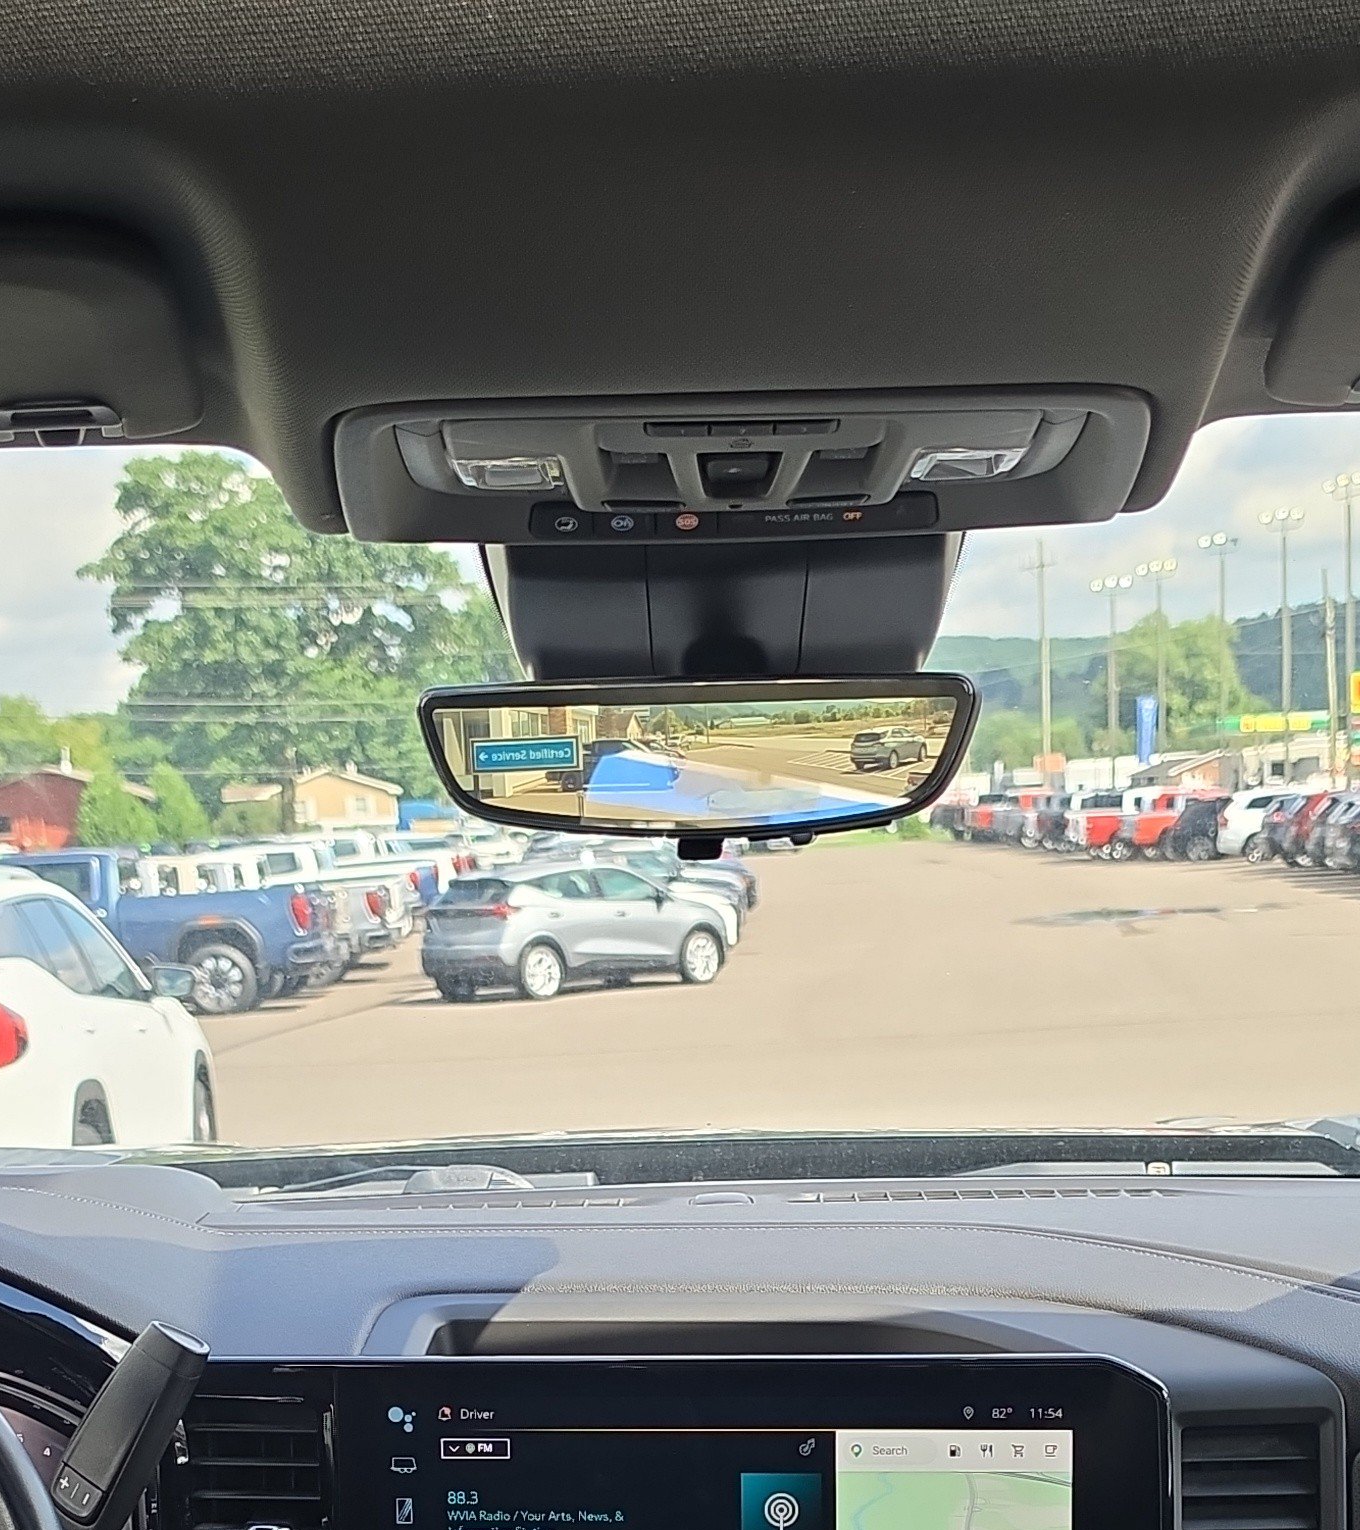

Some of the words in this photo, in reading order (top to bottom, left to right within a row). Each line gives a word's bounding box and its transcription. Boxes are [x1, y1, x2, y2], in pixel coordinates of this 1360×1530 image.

[765, 514, 791, 523] PASS
[793, 513, 810, 522] AIR
[813, 513, 834, 521] BAG
[842, 511, 863, 521] OFF
[460, 1408, 495, 1420] Driver
[1029, 1408, 1063, 1419] 11:54
[477, 1442, 493, 1453] FM
[872, 1445, 908, 1456] Search
[447, 1490, 479, 1505] 88.3
[447, 1510, 477, 1521] WVIA
[479, 1510, 511, 1521] Radio
[520, 1510, 545, 1522] Your
[548, 1510, 575, 1523] Arts,
[578, 1510, 612, 1523] News,
[614, 1510, 625, 1522] &
